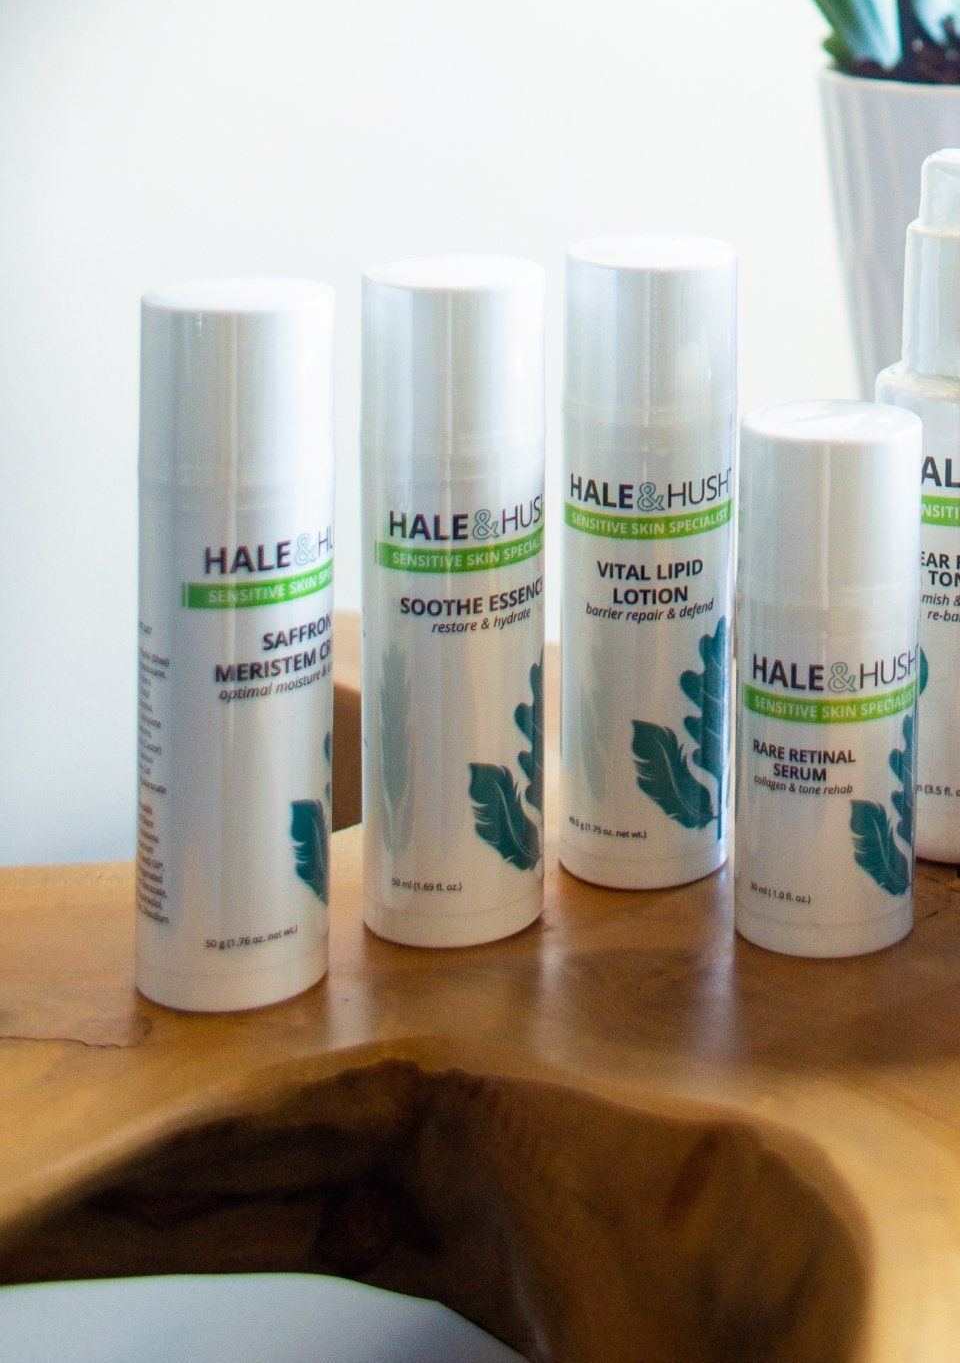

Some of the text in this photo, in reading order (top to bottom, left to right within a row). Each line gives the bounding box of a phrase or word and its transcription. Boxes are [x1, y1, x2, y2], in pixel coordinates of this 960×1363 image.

[572, 507, 729, 535] SENSITIVE SKIN SPECIALIST
[392, 551, 463, 568] SENSITIVE
[467, 553, 500, 566] SKIN
[597, 558, 704, 581] VITAL LIPID
[207, 583, 286, 604] SENSITIVE
[289, 575, 317, 592] SKIN
[613, 585, 688, 606] LOTION
[400, 596, 484, 617] SOOTHE
[586, 597, 714, 624] barrier repair & defend
[262, 613, 331, 651] SAFFRON
[432, 607, 531, 634] restore & hydrate
[215, 646, 317, 683] MERISTEM
[219, 681, 272, 703] optimal
[275, 671, 320, 694] moisture
[754, 694, 817, 719] SENSITIVE
[821, 705, 857, 719] SKIN
[753, 738, 856, 764] RARE RETINAL
[754, 775, 853, 795] collagen & tone rehab
[773, 763, 827, 782] SERUM
